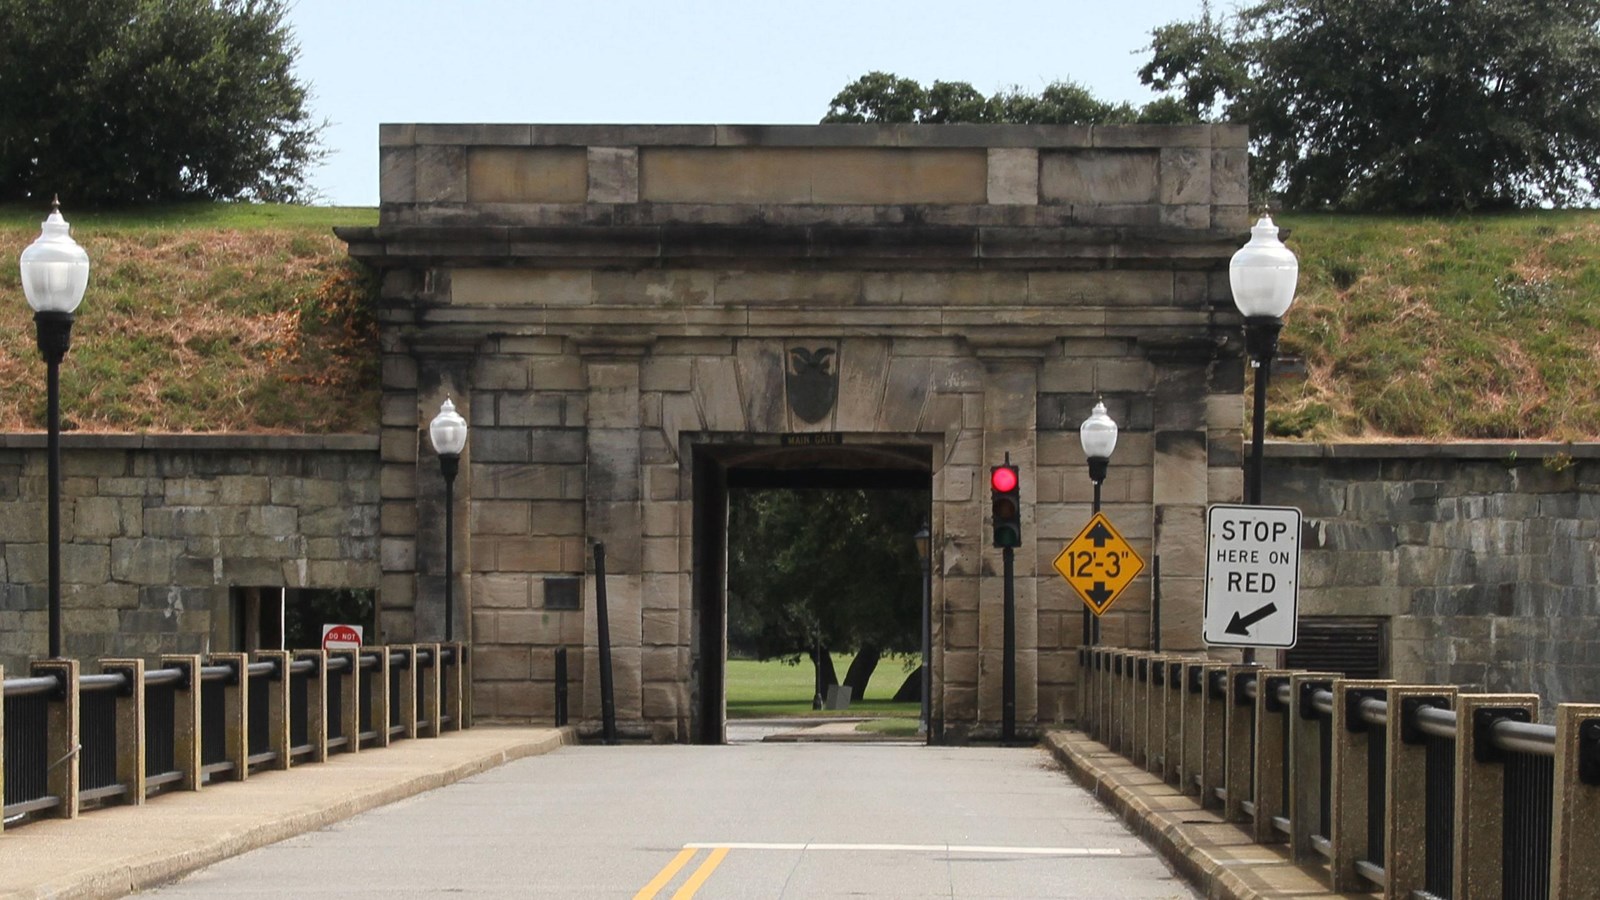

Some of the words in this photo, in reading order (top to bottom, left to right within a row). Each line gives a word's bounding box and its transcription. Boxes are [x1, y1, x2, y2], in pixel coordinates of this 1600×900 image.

[788, 435, 810, 445] MAIN
[814, 434, 836, 445] GATE
[1222, 520, 1287, 542] STOP
[1068, 551, 1129, 578] 12'-3"
[1217, 549, 1259, 563] HERE
[1269, 551, 1290, 564] ON
[1227, 571, 1276, 593] RED
[328, 632, 339, 640] DO
